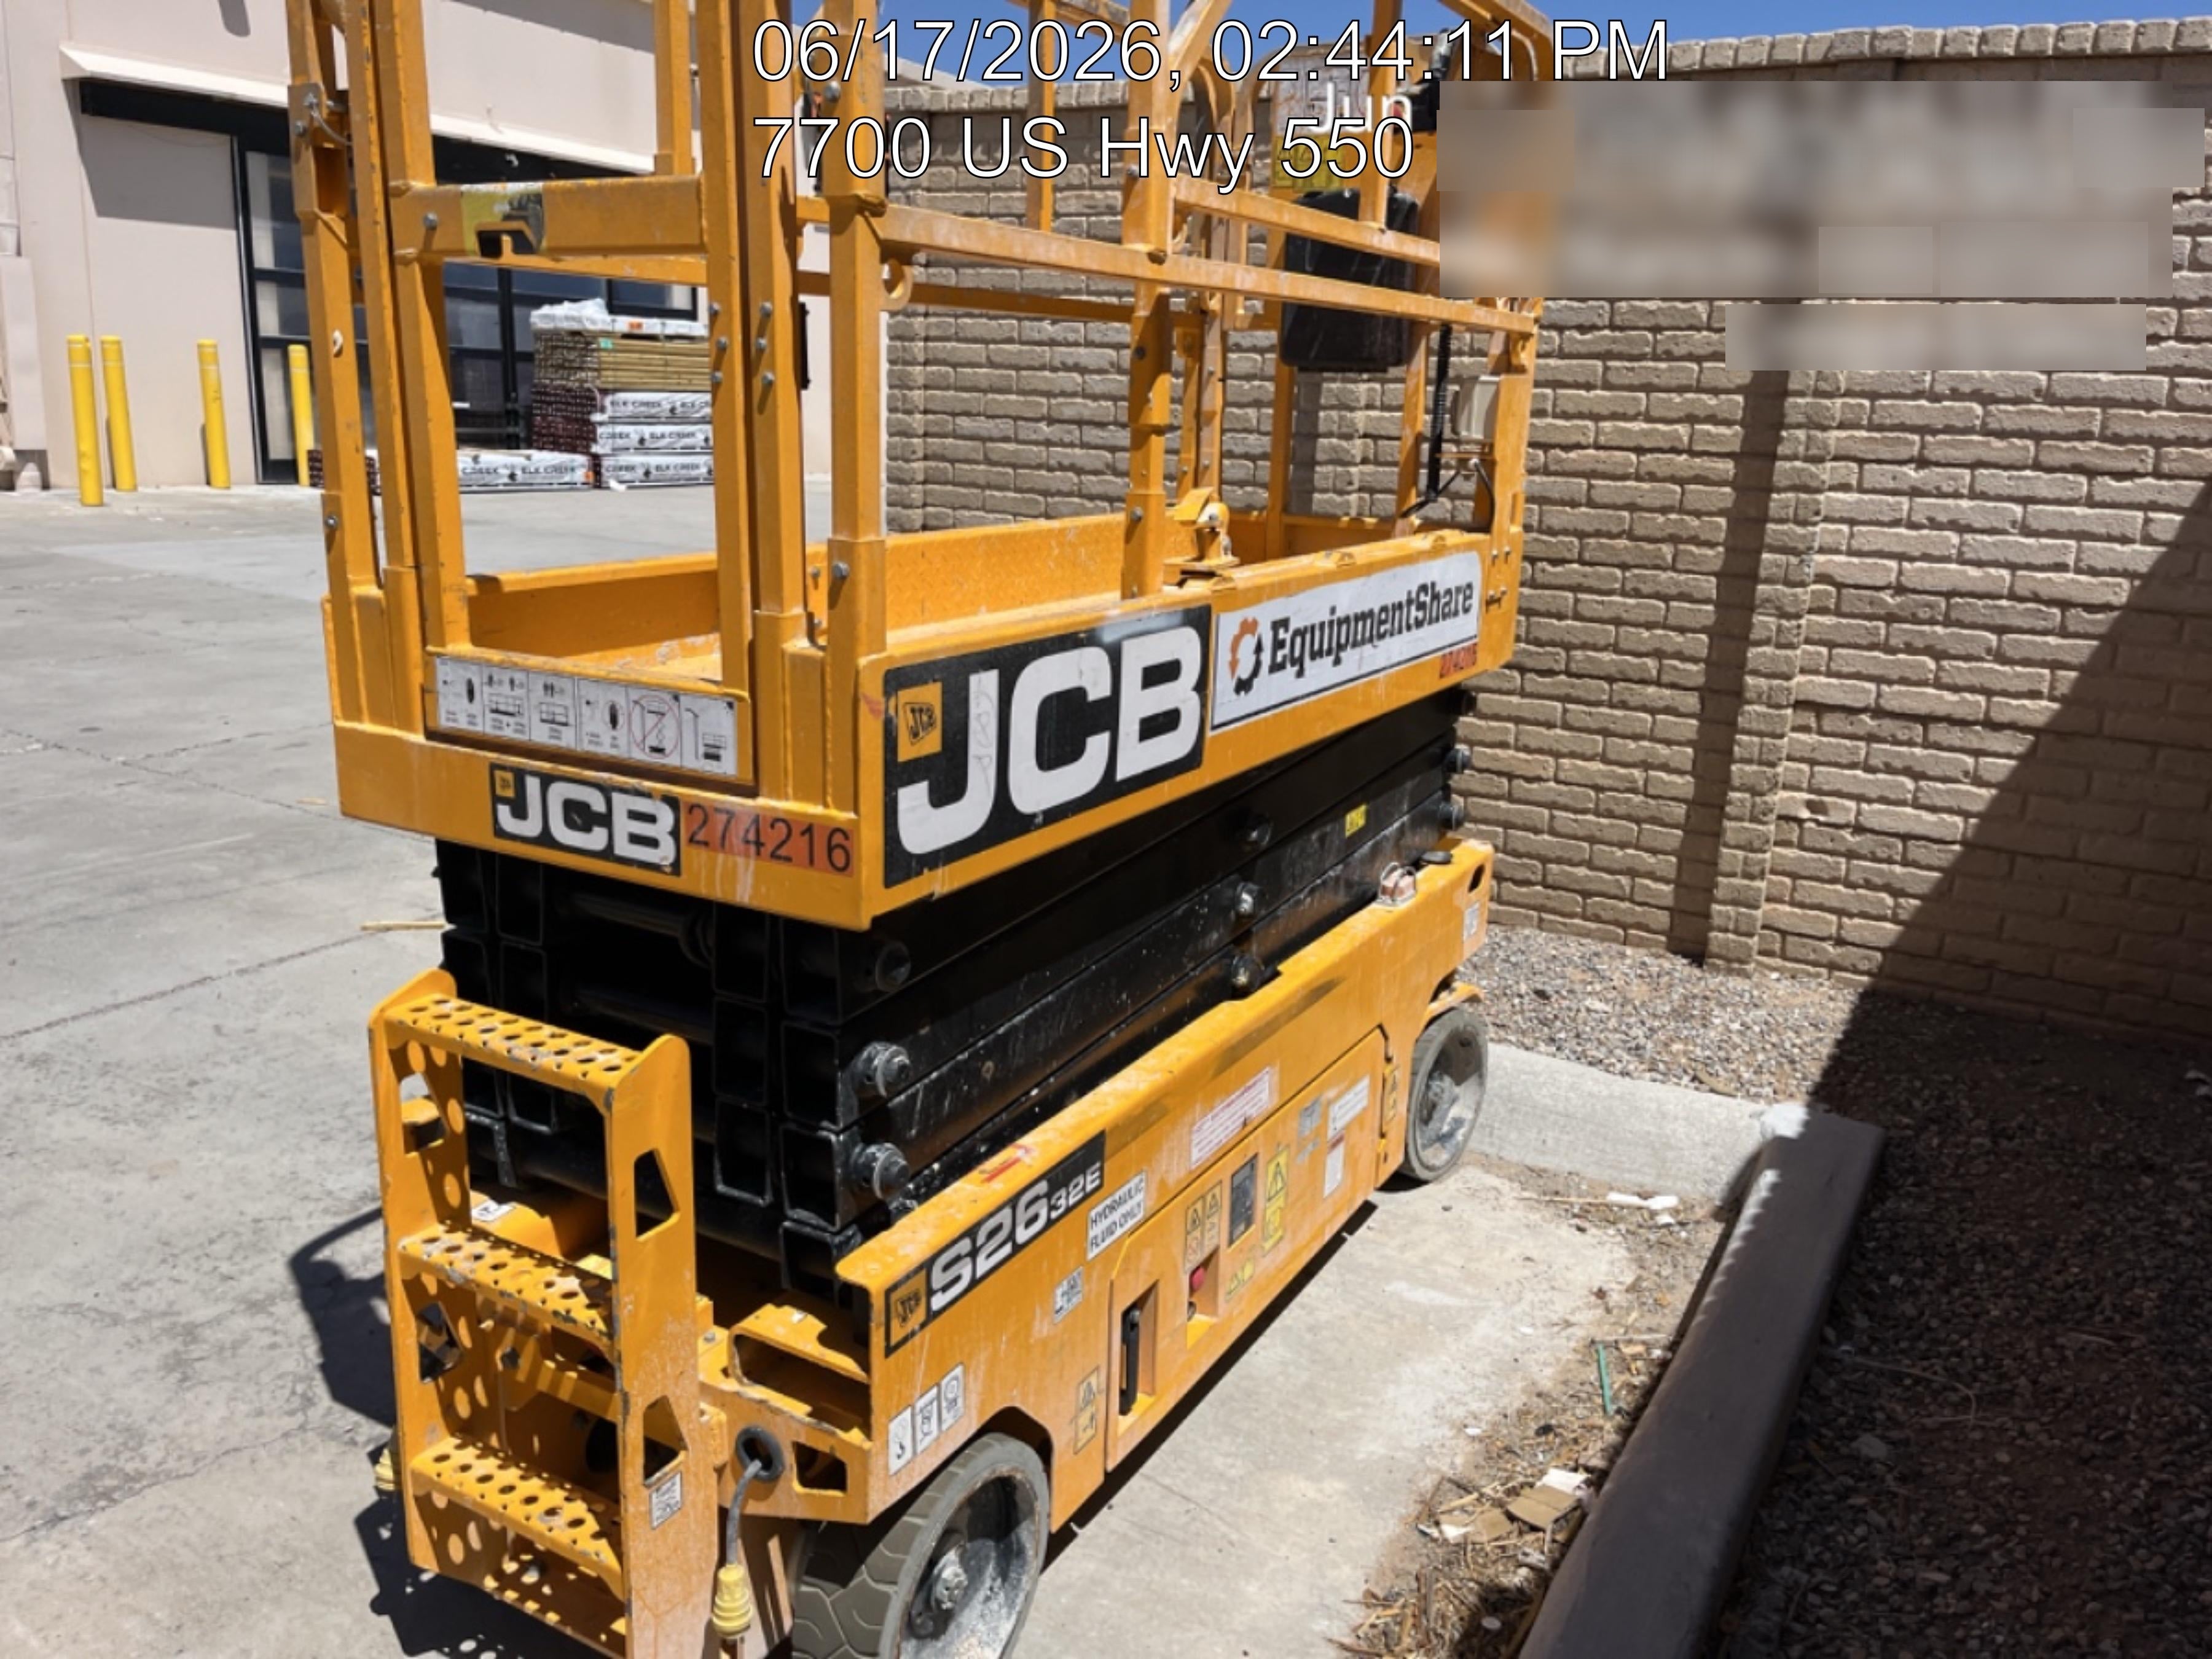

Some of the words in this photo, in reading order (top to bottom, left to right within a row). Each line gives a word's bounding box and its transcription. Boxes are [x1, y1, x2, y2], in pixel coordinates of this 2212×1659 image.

[1268, 581, 1473, 678] EquipmentShare
[896, 626, 1201, 855] JCB
[496, 774, 677, 863] JCB
[688, 803, 853, 873] 274216
[930, 1179, 1048, 1312] S26
[1050, 1161, 1102, 1220] 32E
